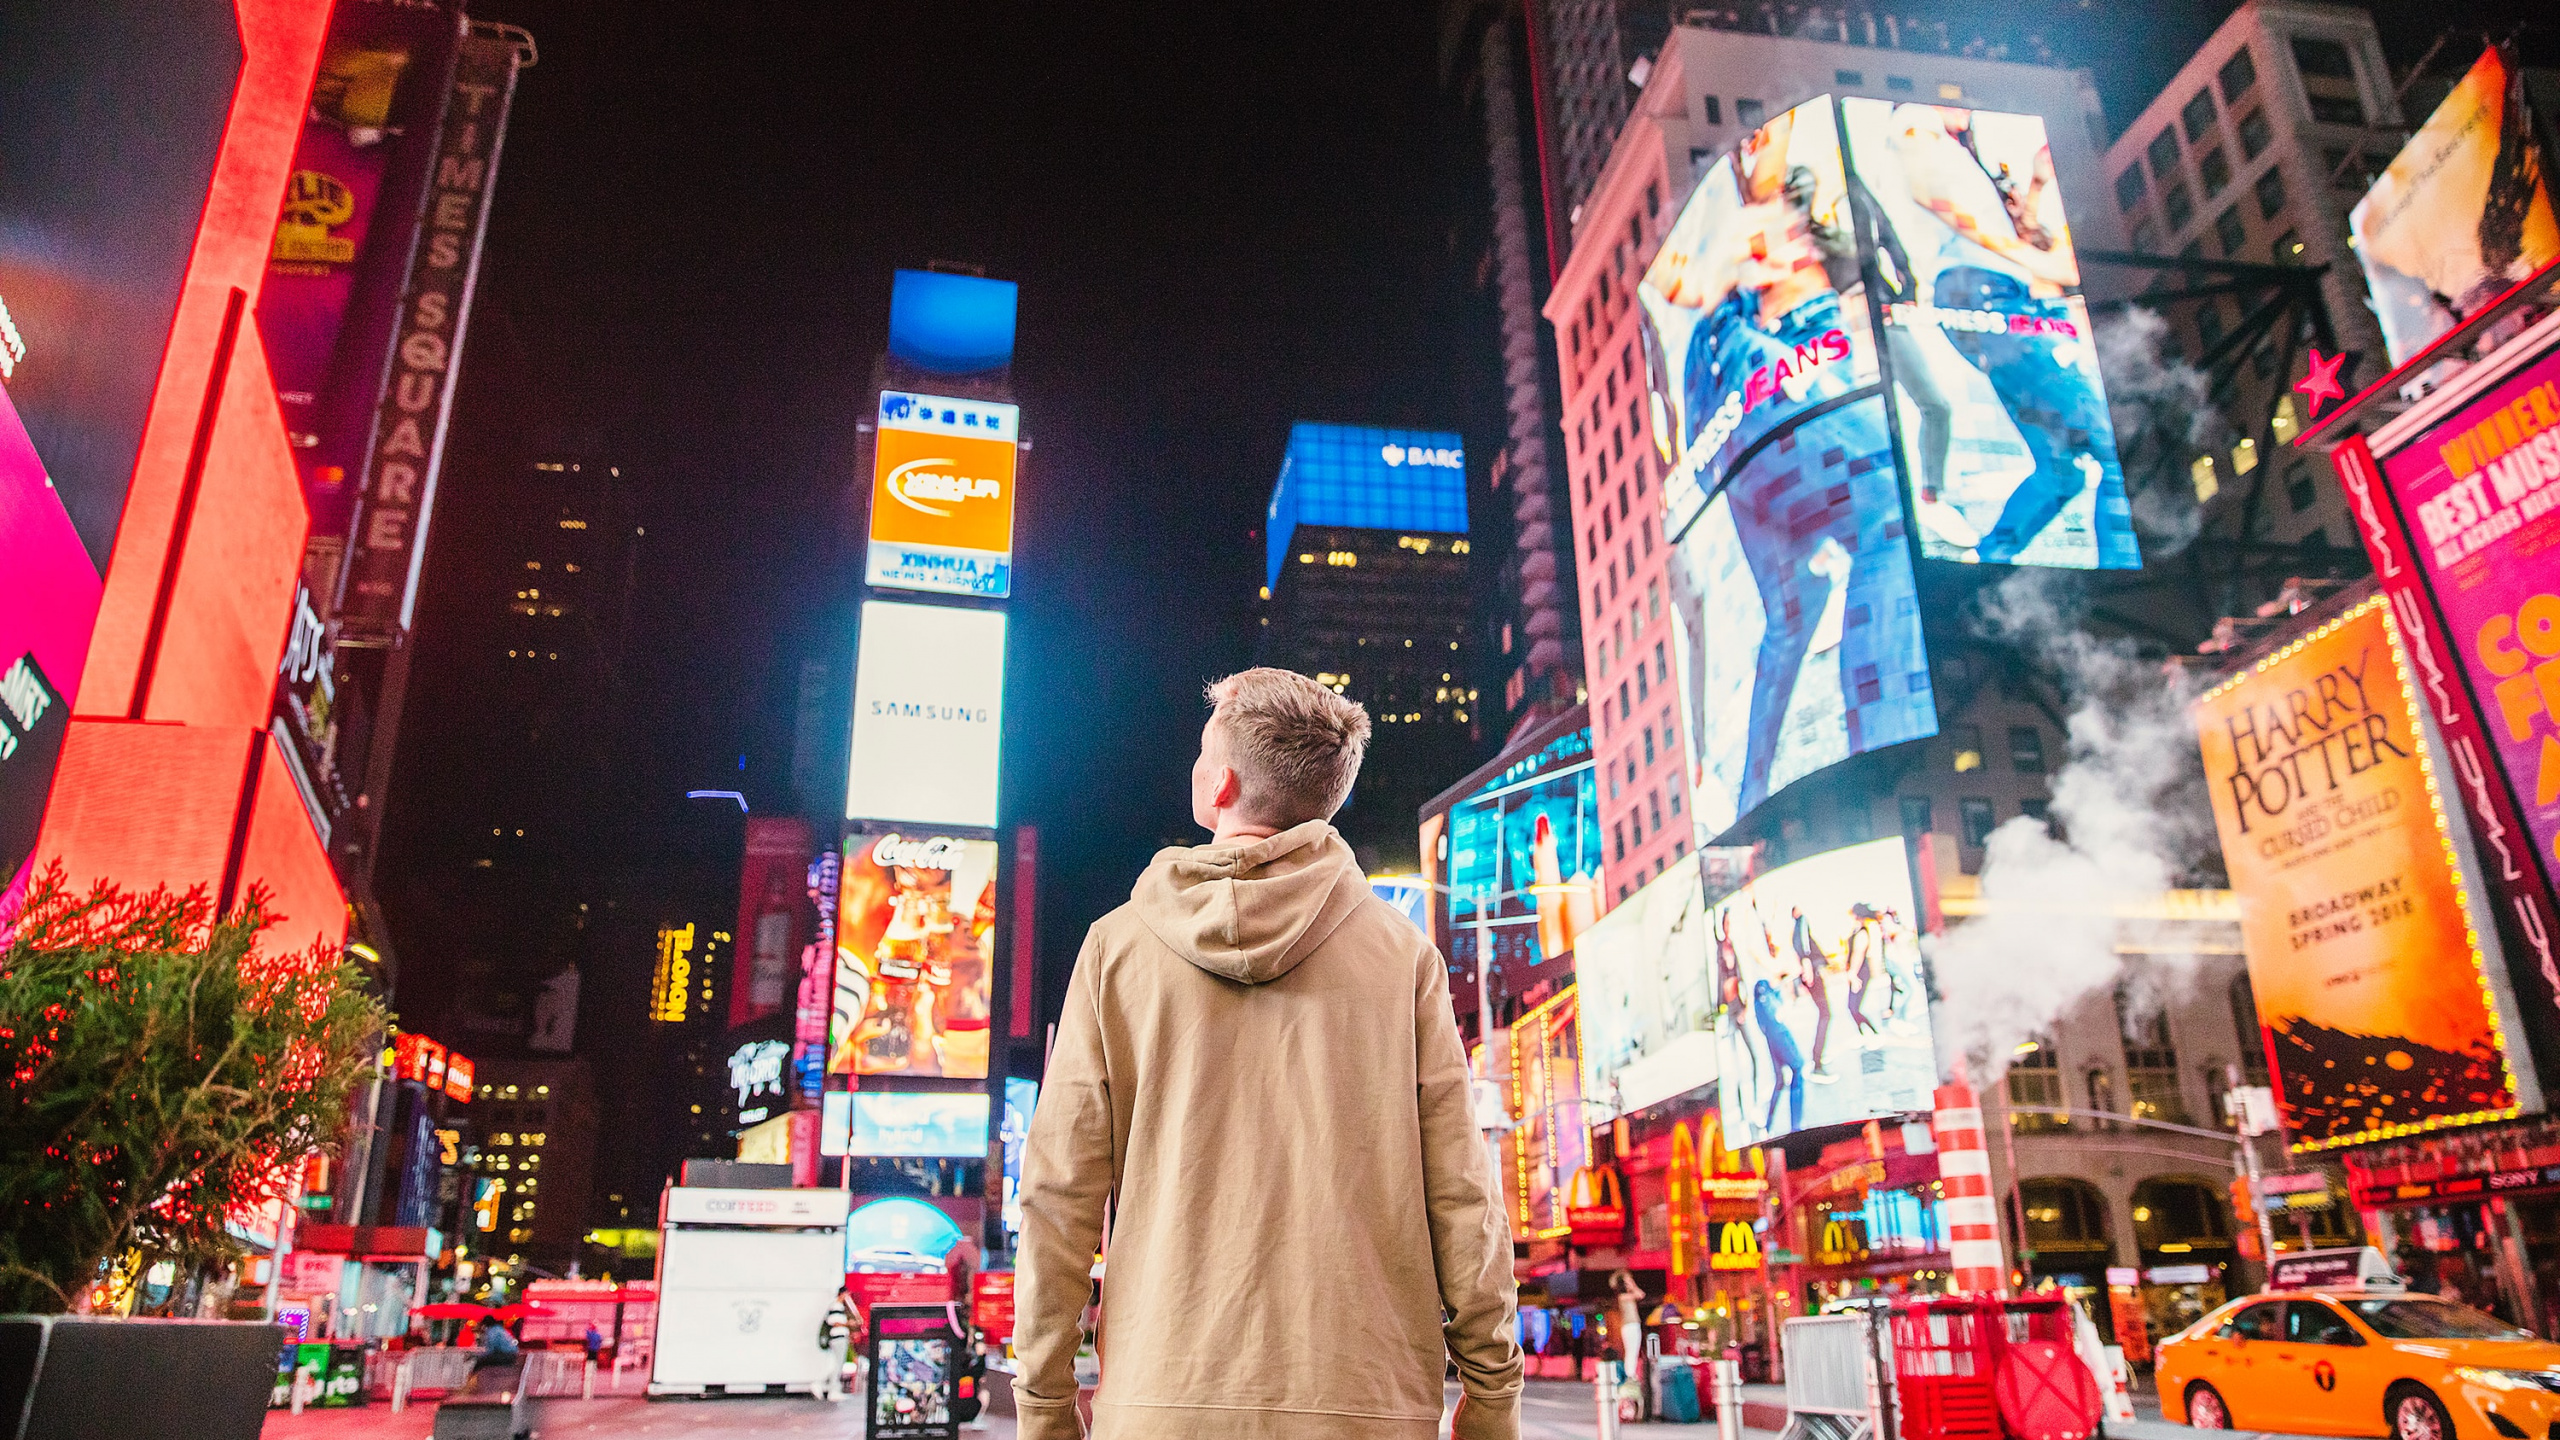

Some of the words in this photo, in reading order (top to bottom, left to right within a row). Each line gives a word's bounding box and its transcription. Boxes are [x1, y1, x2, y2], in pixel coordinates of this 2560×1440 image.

[427, 82, 497, 268] TIMES
[1743, 328, 1850, 414] JEANS
[367, 290, 447, 549] SQUARE
[1407, 446, 1464, 470] BARC
[2417, 471, 2493, 549] BEST
[900, 551, 978, 577] XINHUA
[870, 699, 988, 724] SAMSUNG
[2224, 645, 2372, 772] HARRY
[2228, 712, 2411, 835] POTTER
[2259, 814, 2332, 862] CURSED
[2334, 786, 2401, 831] CHILD
[2287, 876, 2403, 928] BROADWAY
[2290, 913, 2363, 953] SPRING
[664, 921, 695, 1022] NOVOTEL
[2489, 1170, 2538, 1190] SONY
